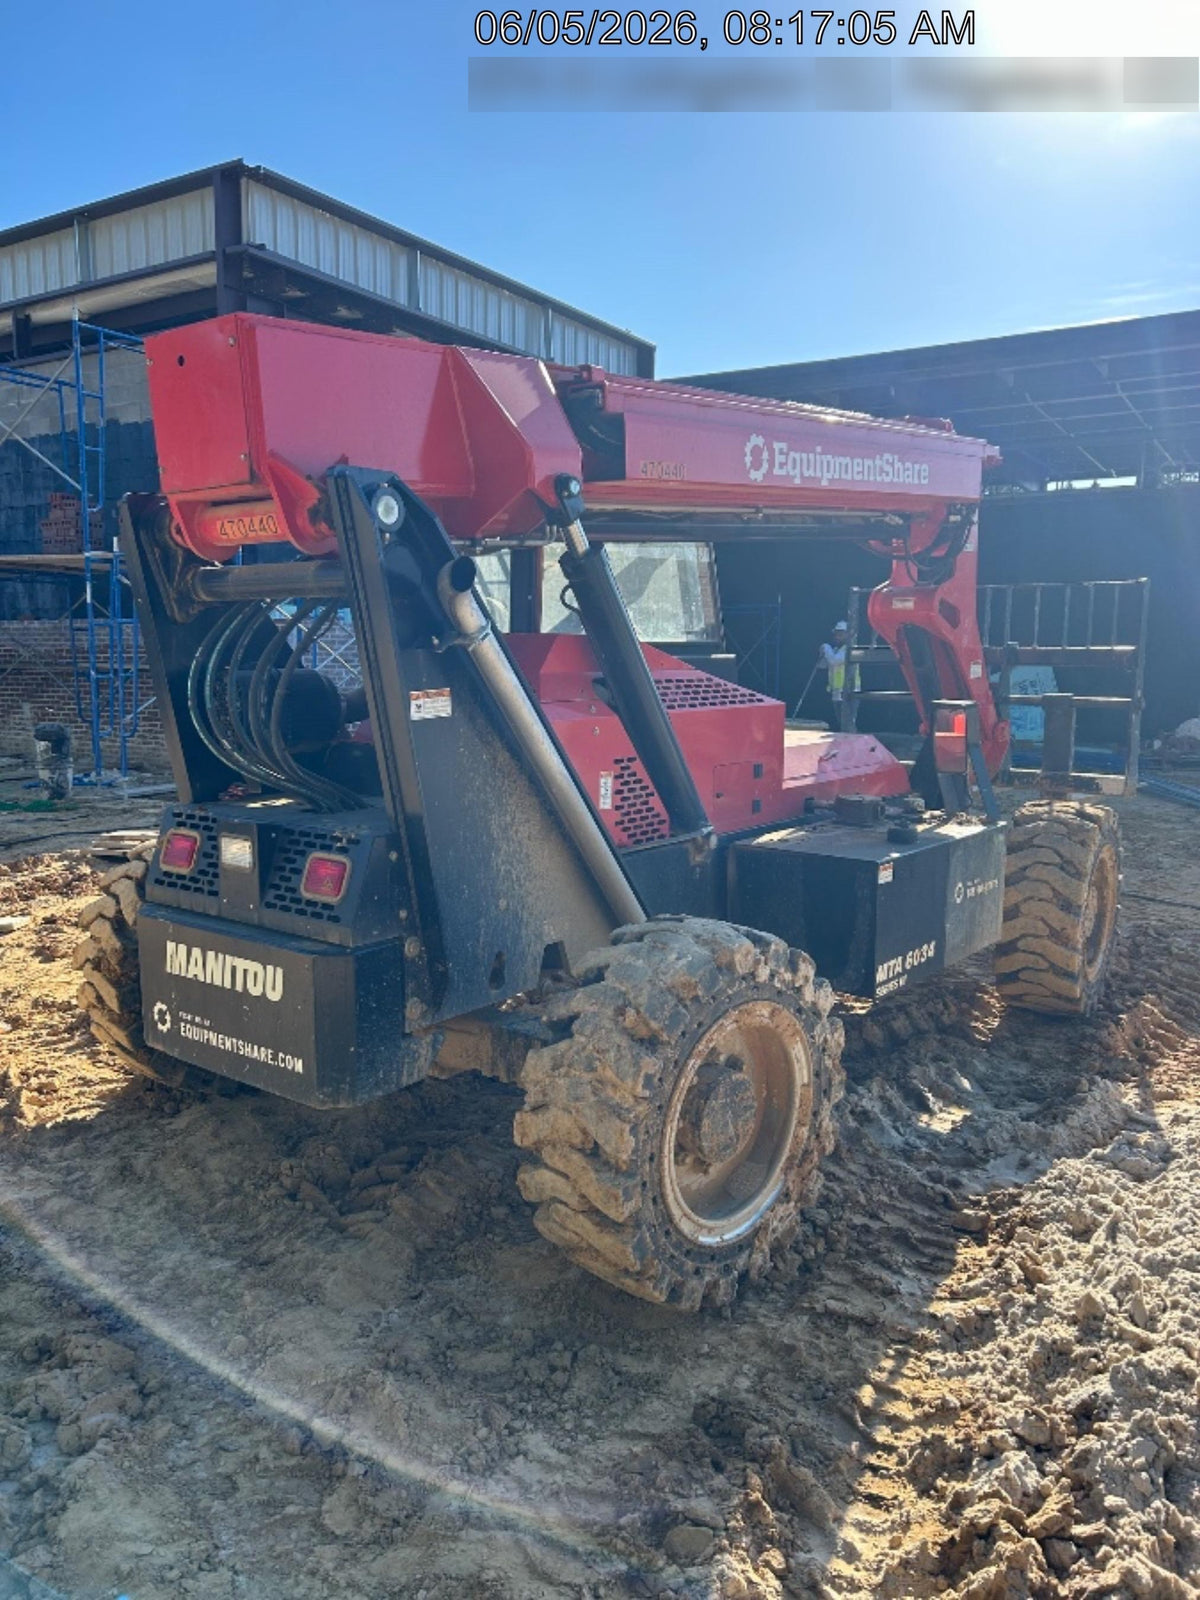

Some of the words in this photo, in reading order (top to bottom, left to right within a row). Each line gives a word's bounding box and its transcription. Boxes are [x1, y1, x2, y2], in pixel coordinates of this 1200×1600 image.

[641, 461, 686, 480] 470440
[773, 441, 929, 486] EquipmentShare
[220, 515, 278, 538] 470440
[166, 940, 284, 1002] MANITOU
[876, 956, 902, 984] MTA
[180, 1022, 303, 1074] EQUIPMENTSHARE.COM
